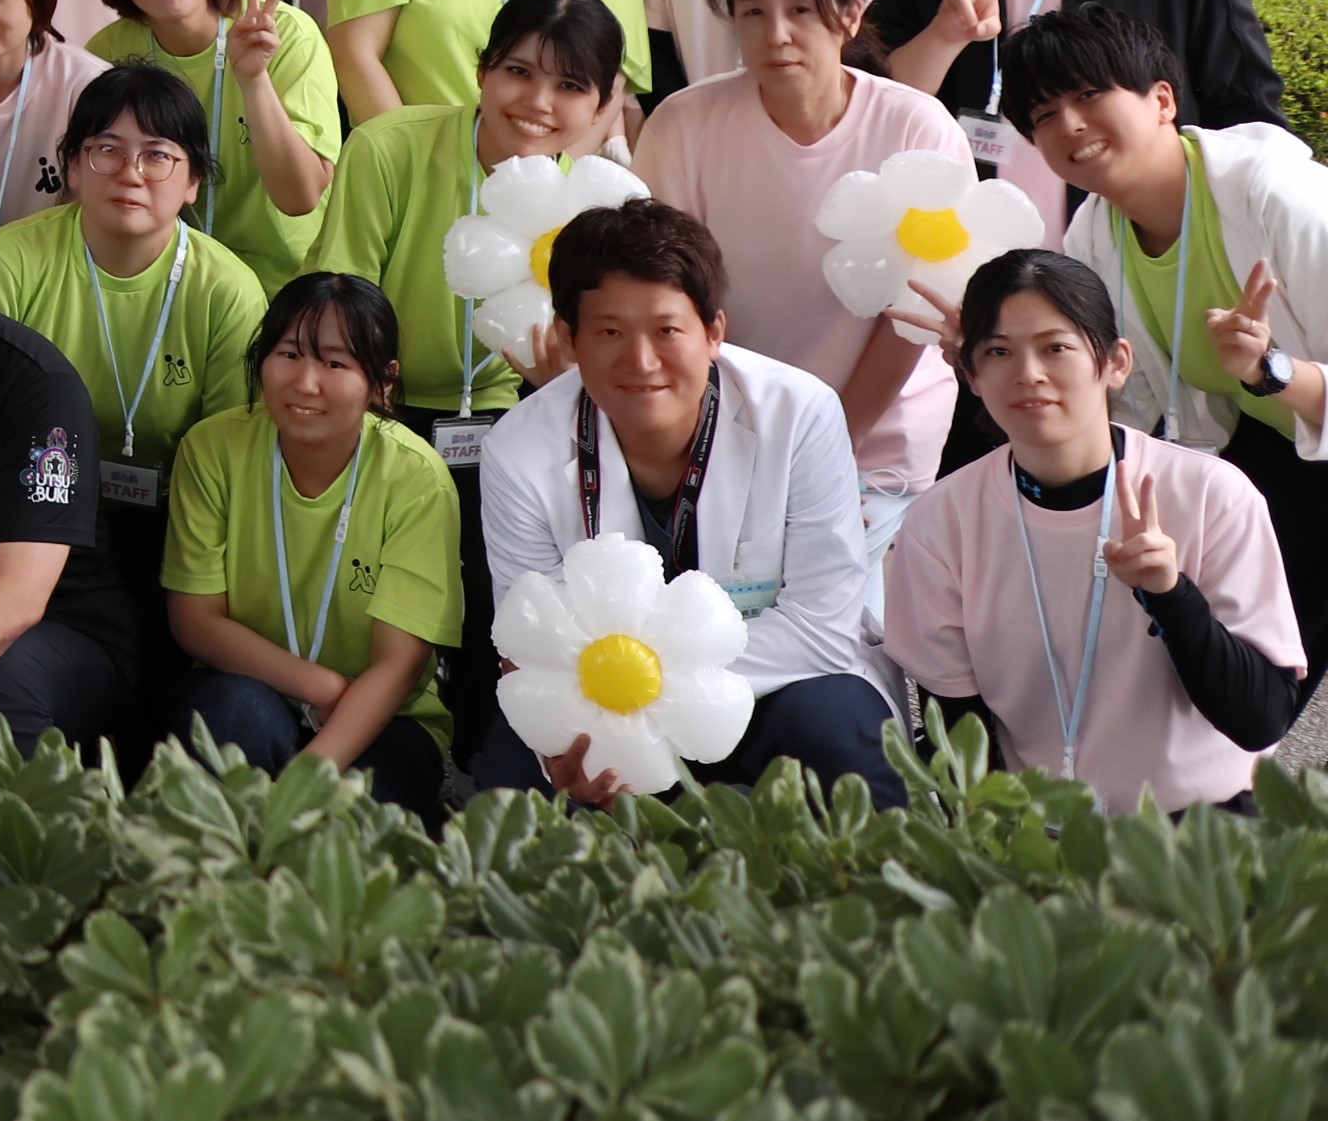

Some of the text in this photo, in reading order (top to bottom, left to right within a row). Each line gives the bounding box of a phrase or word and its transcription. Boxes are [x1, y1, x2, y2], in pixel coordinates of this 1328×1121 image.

[442, 445, 481, 458] STAFF
[36, 473, 70, 488] UTSU
[36, 486, 69, 504] BUKI
[103, 481, 150, 499] STAFF
